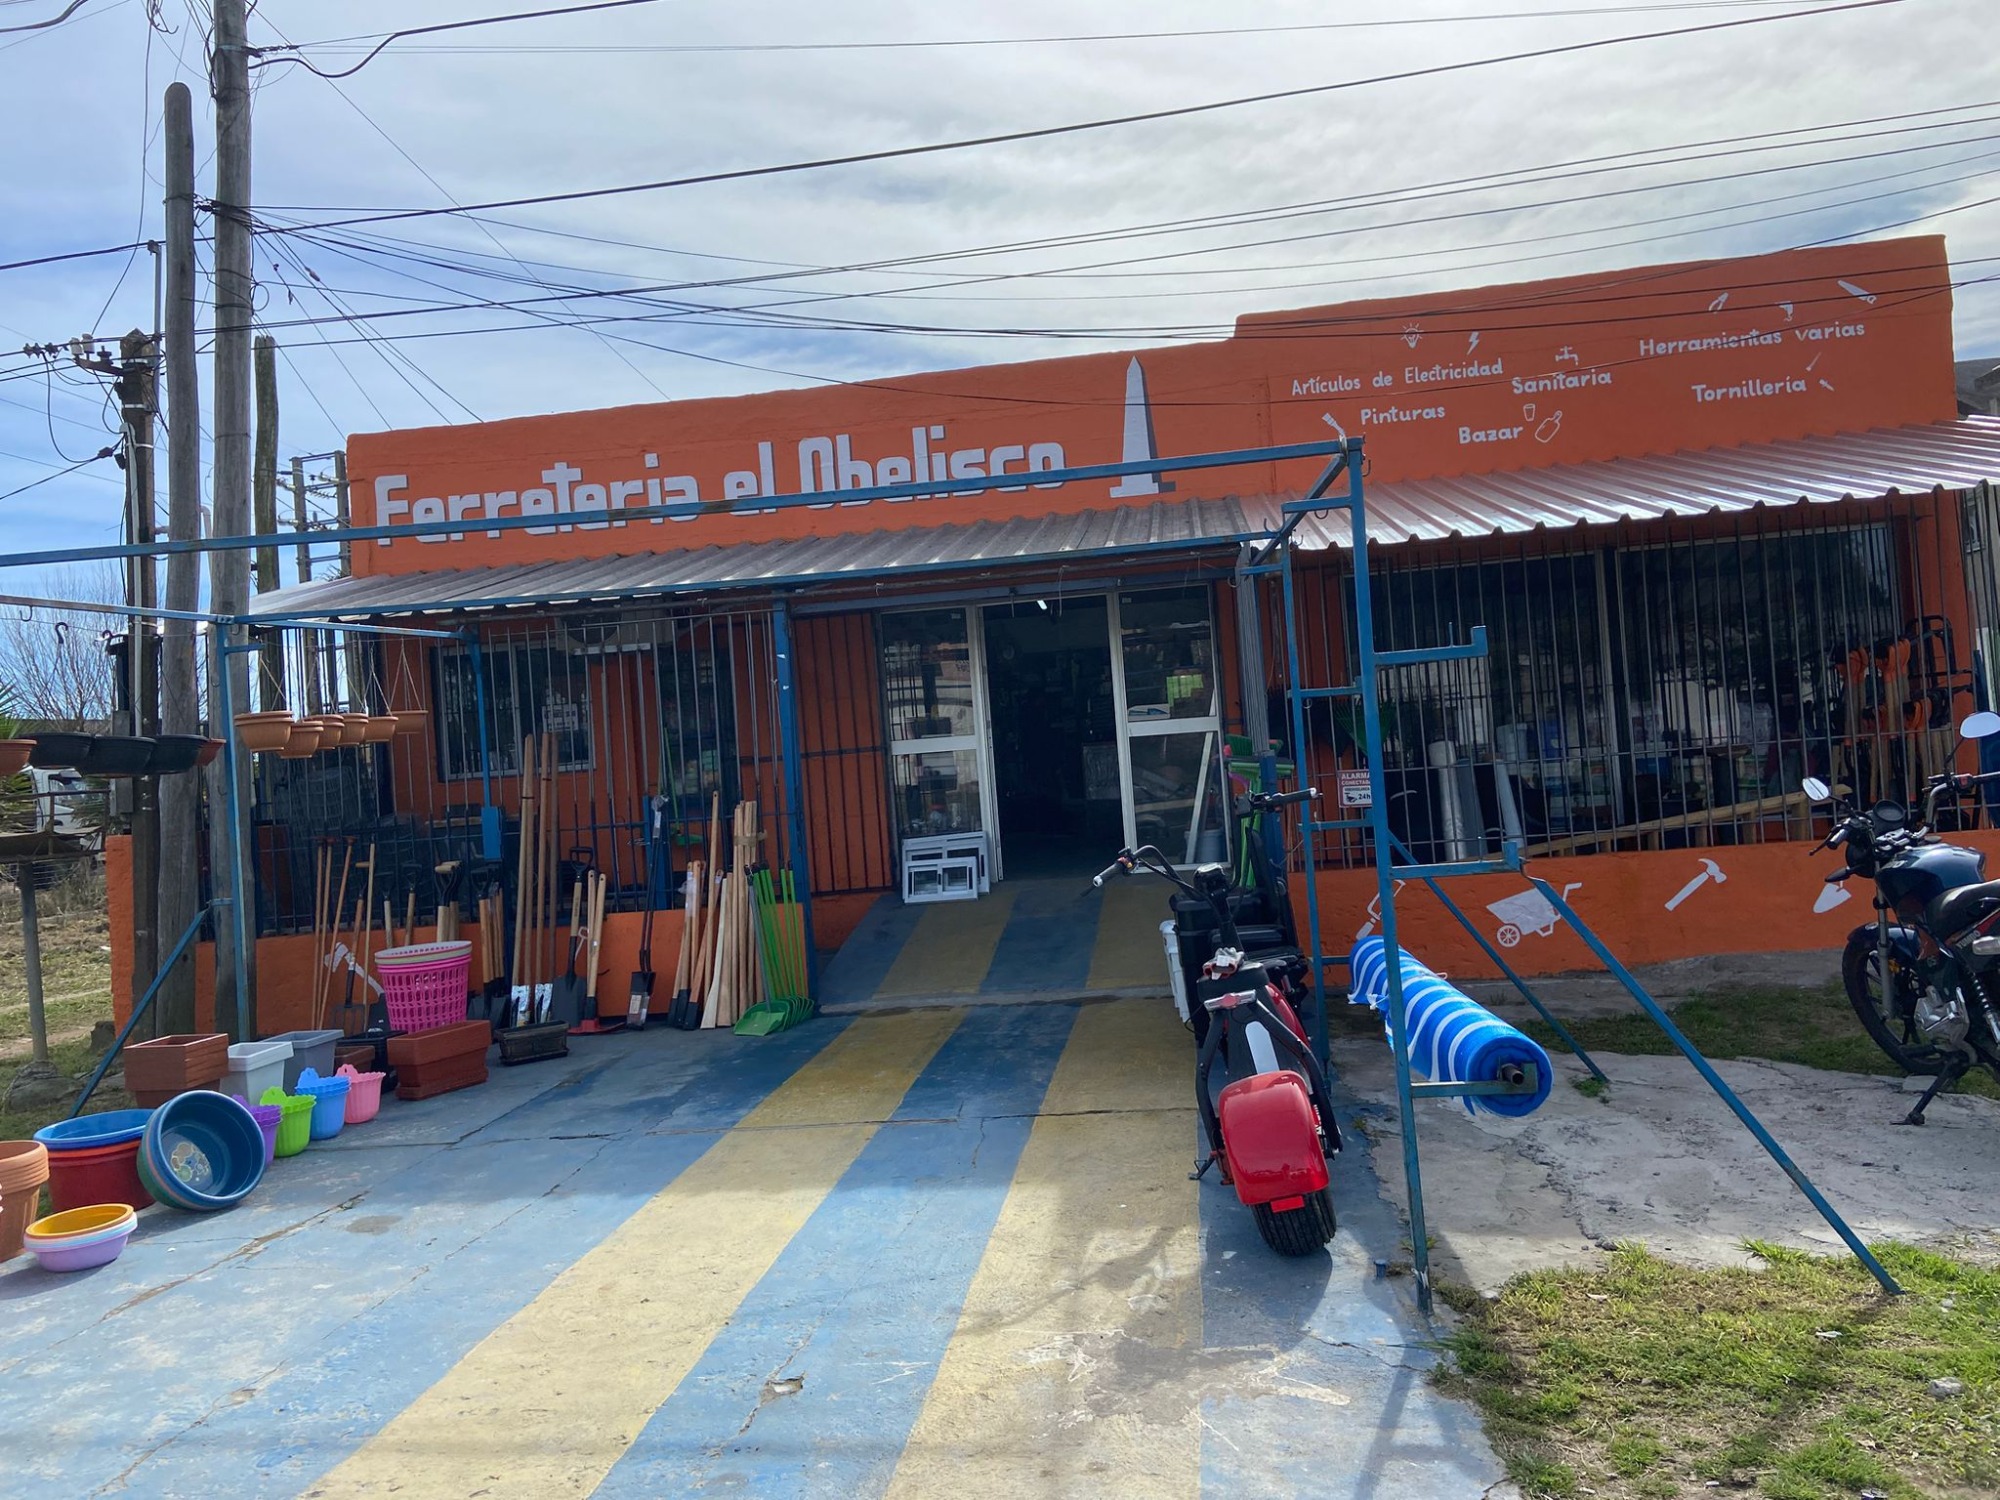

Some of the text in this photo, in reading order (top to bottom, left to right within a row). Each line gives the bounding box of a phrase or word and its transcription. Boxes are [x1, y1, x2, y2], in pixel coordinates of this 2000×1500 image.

[1640, 321, 1866, 356] Herramientas varias
[1291, 357, 1504, 396] Artículos de Electricidad
[1511, 368, 1613, 395] Sanitaria
[1691, 375, 1808, 403] Tornillería
[1360, 403, 1446, 426] Pinturas
[1457, 423, 1525, 446] Bazar
[374, 424, 1067, 547] Ferreteria el Obelisco
